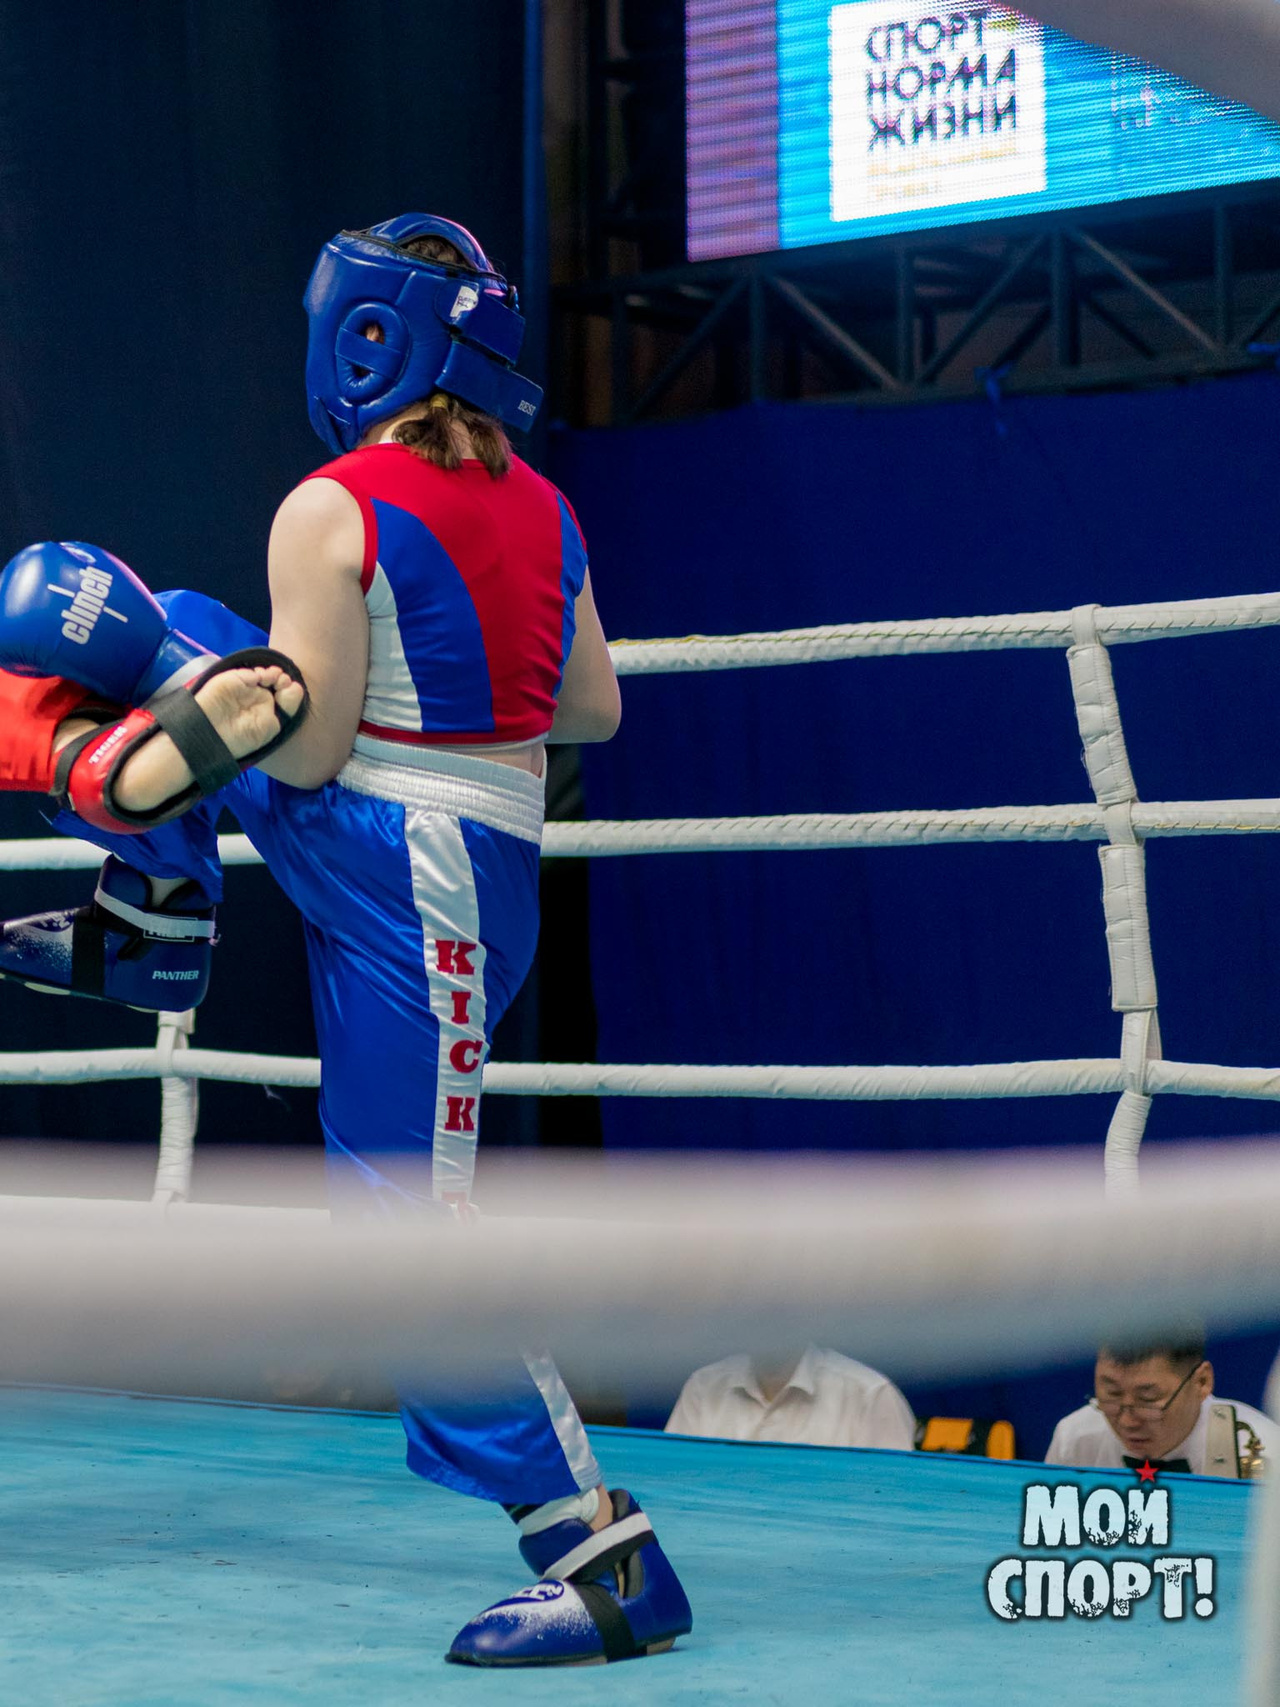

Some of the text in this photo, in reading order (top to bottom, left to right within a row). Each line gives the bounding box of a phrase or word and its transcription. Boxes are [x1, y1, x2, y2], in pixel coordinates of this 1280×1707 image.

[866, 9, 987, 62] СПОРТ
[866, 48, 1016, 111] НОРМА
[868, 94, 1016, 150] ЖИЗНИ
[61, 565, 114, 645] clinch
[151, 970, 200, 981] PANTHER
